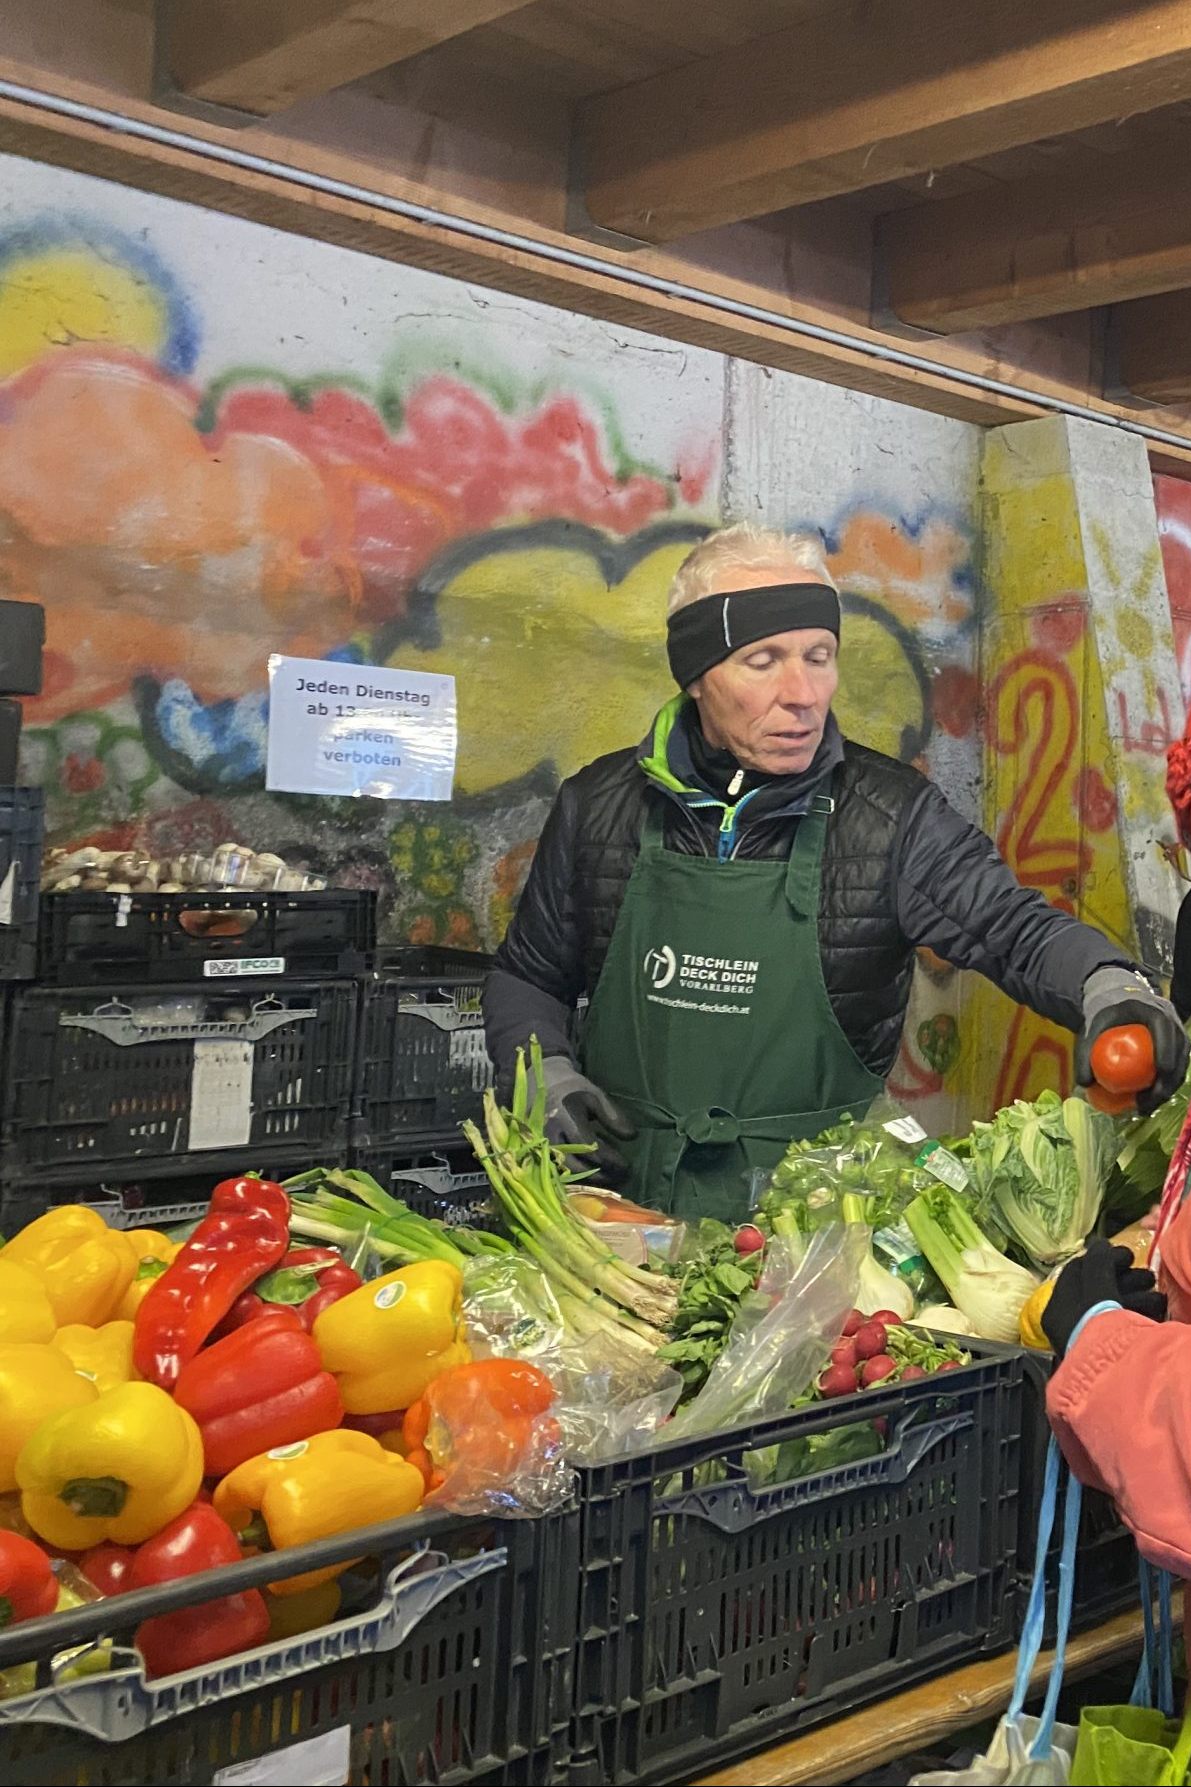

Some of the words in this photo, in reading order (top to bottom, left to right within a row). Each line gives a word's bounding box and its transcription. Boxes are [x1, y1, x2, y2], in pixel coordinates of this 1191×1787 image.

[296, 678, 350, 696] Jeden
[355, 684, 431, 707] Dienstag
[306, 702, 328, 716] ab
[323, 749, 401, 766] verboten
[681, 954, 759, 971] TISCHLEIN
[680, 966, 718, 981] DECK
[720, 971, 757, 984] DICH
[680, 979, 754, 994] VORARLBERG
